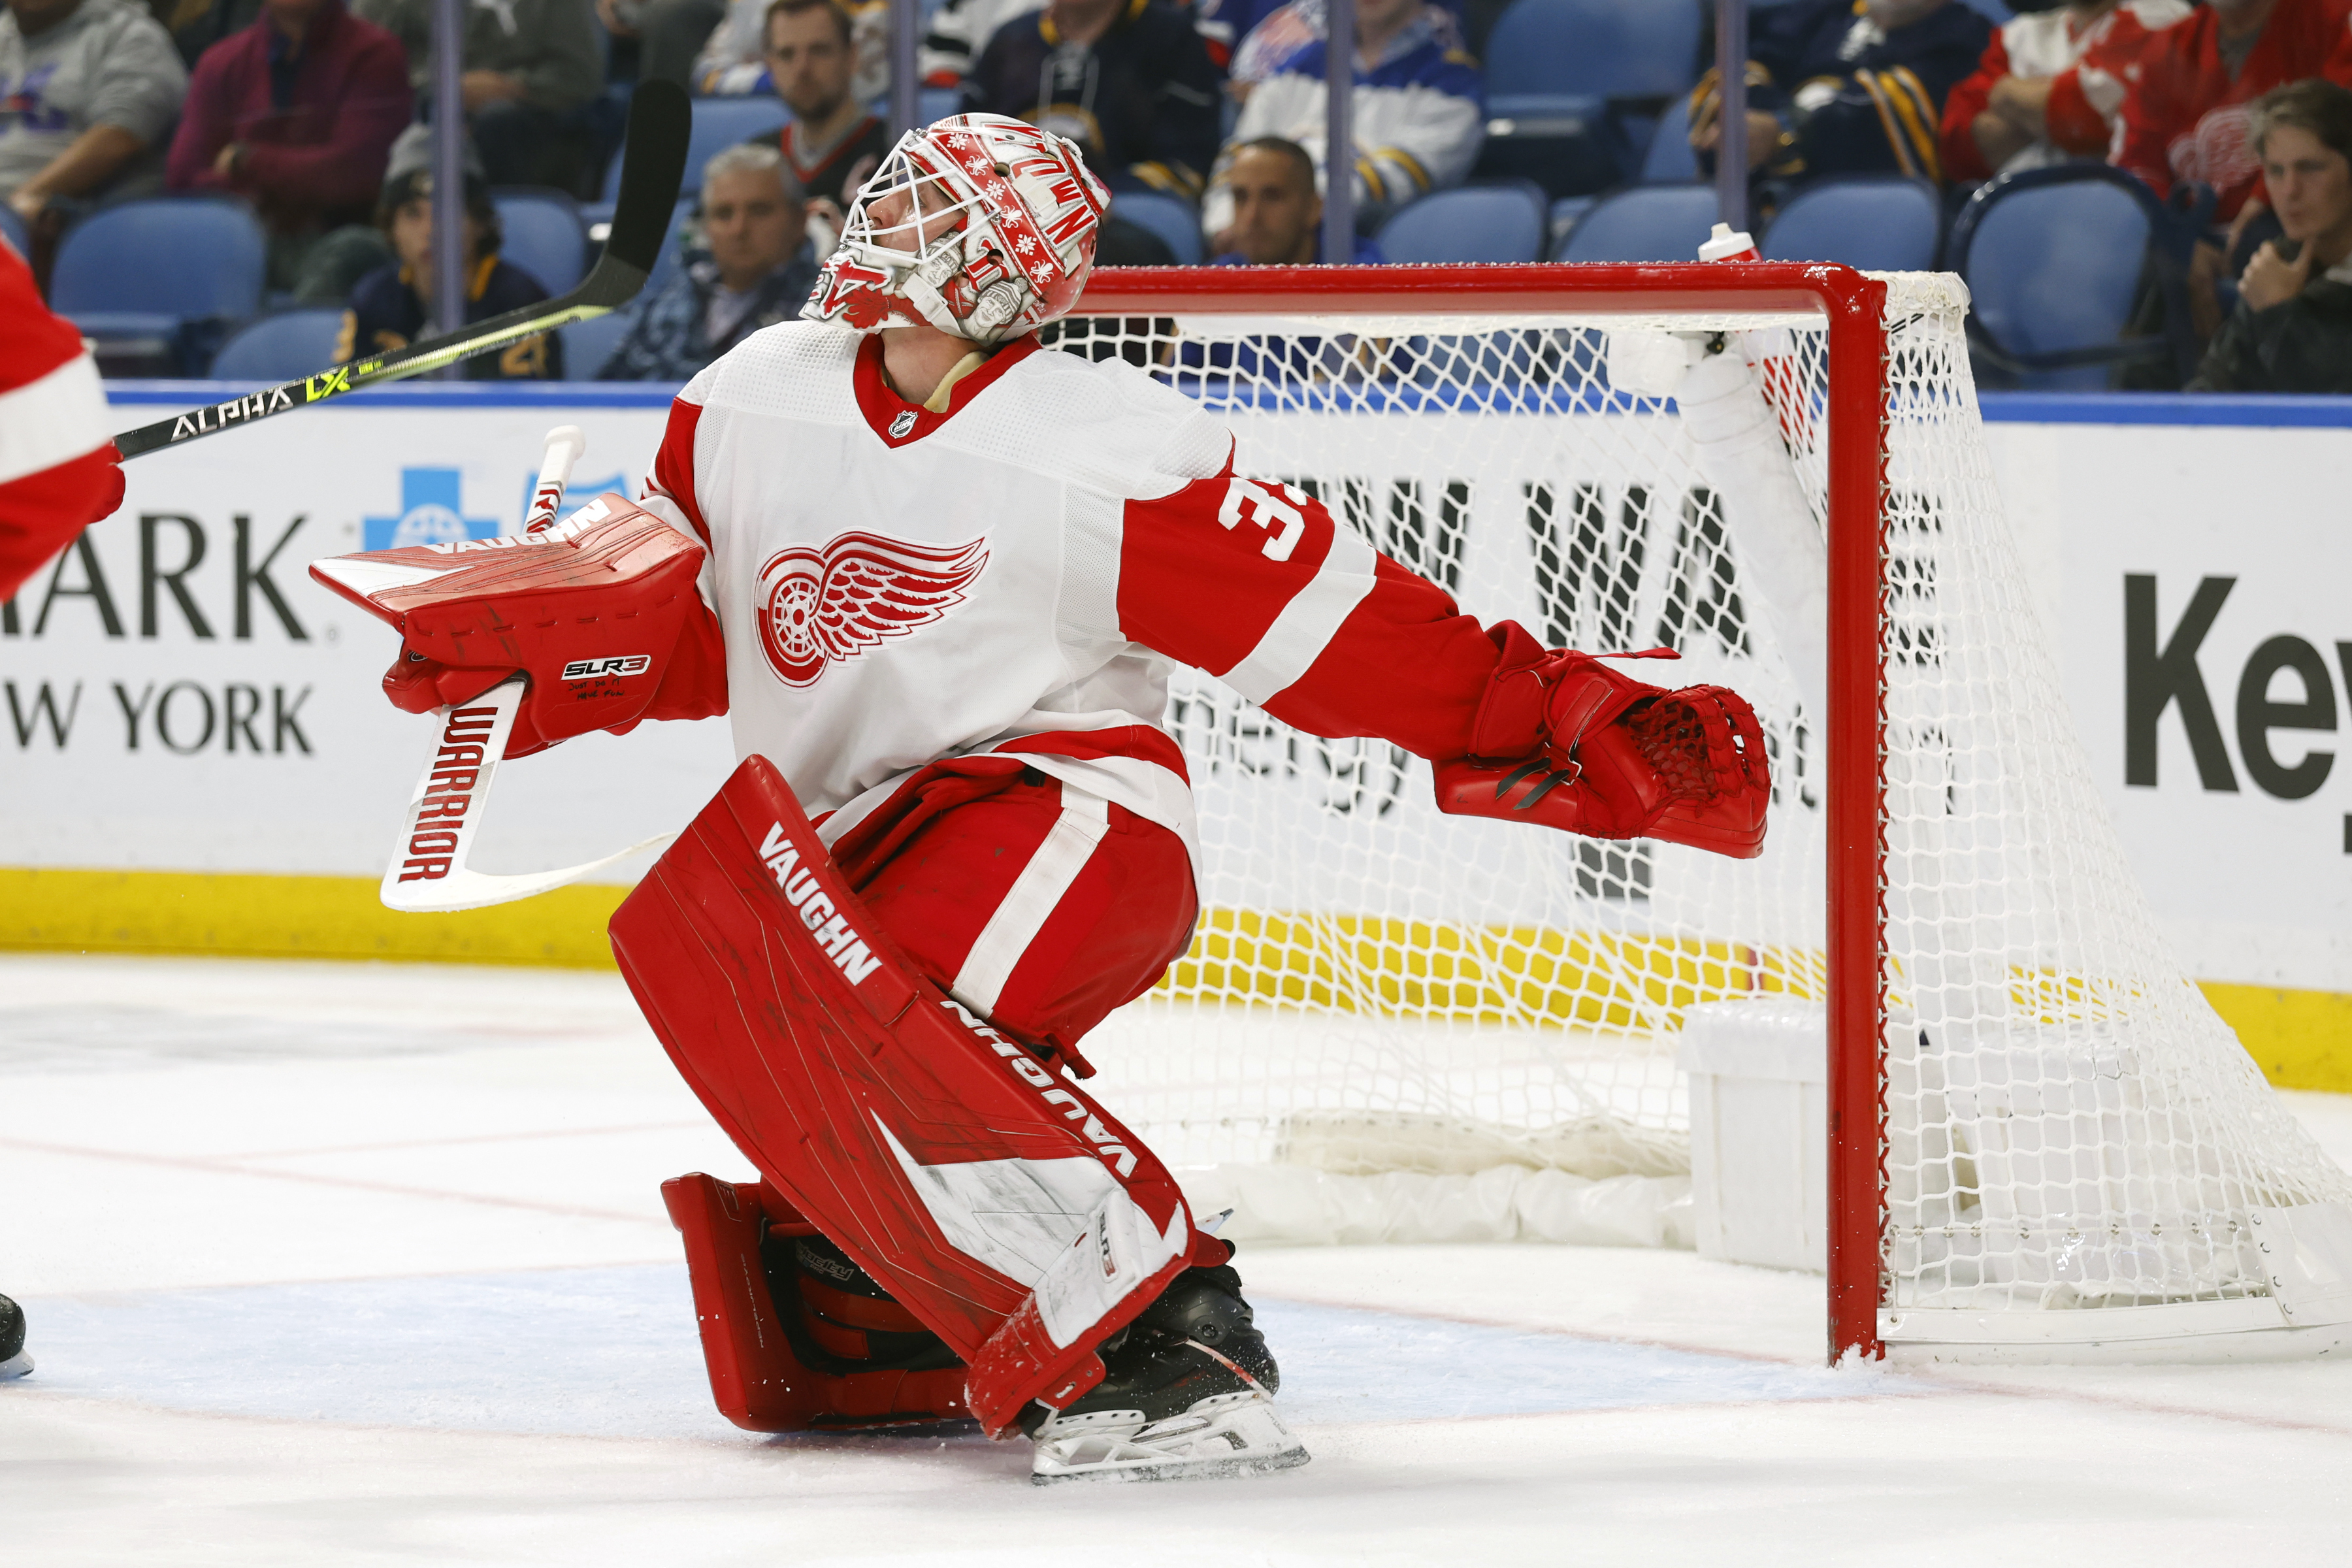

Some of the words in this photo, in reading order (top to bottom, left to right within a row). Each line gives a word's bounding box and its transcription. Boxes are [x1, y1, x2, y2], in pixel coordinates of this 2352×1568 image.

[171, 387, 294, 442] ALPHA
[306, 366, 351, 403] LX
[0, 513, 310, 641] ARK
[421, 498, 612, 555] VAUGHN
[112, 679, 314, 755] YORK
[564, 657, 648, 676] SLR3
[397, 706, 499, 884] WARRIOR
[759, 820, 883, 987] VAUGHN
[939, 1000, 1138, 1179] VAUGHN
